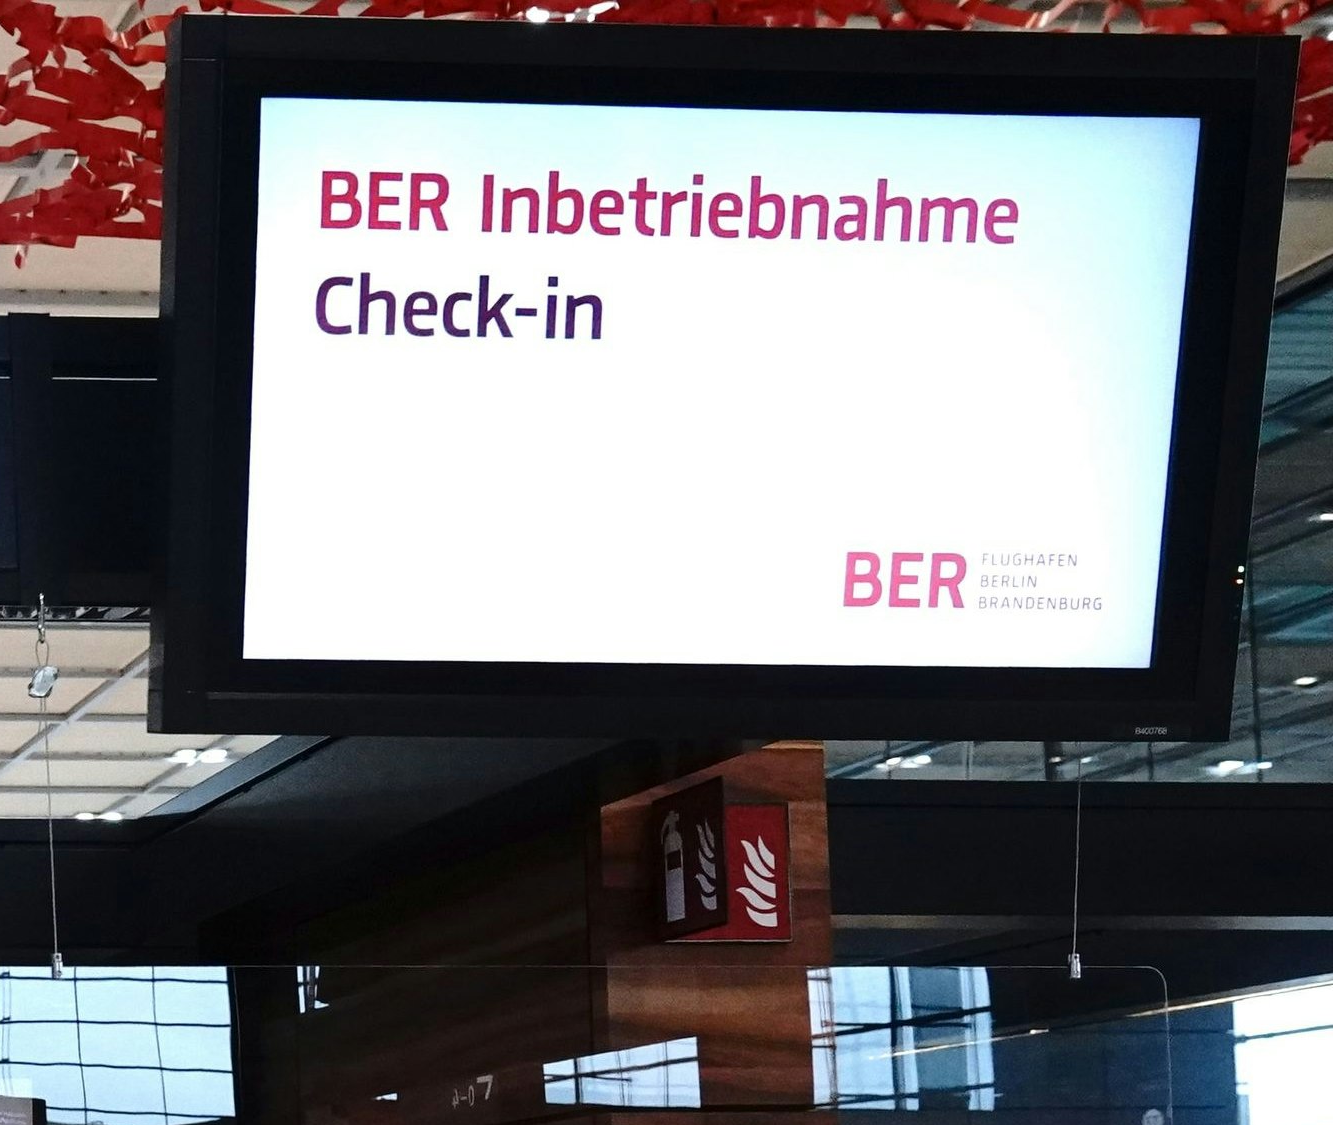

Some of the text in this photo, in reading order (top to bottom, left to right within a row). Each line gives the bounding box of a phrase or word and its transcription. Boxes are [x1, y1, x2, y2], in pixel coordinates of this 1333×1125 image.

[320, 170, 1020, 245] BER Inbetriebnahme
[315, 271, 604, 340] Check-in
[982, 552, 1078, 567] FLUGHAFEN
[843, 551, 967, 609] BER
[980, 575, 1038, 588] BERLIN
[978, 597, 1103, 611] BRANDENBURG
